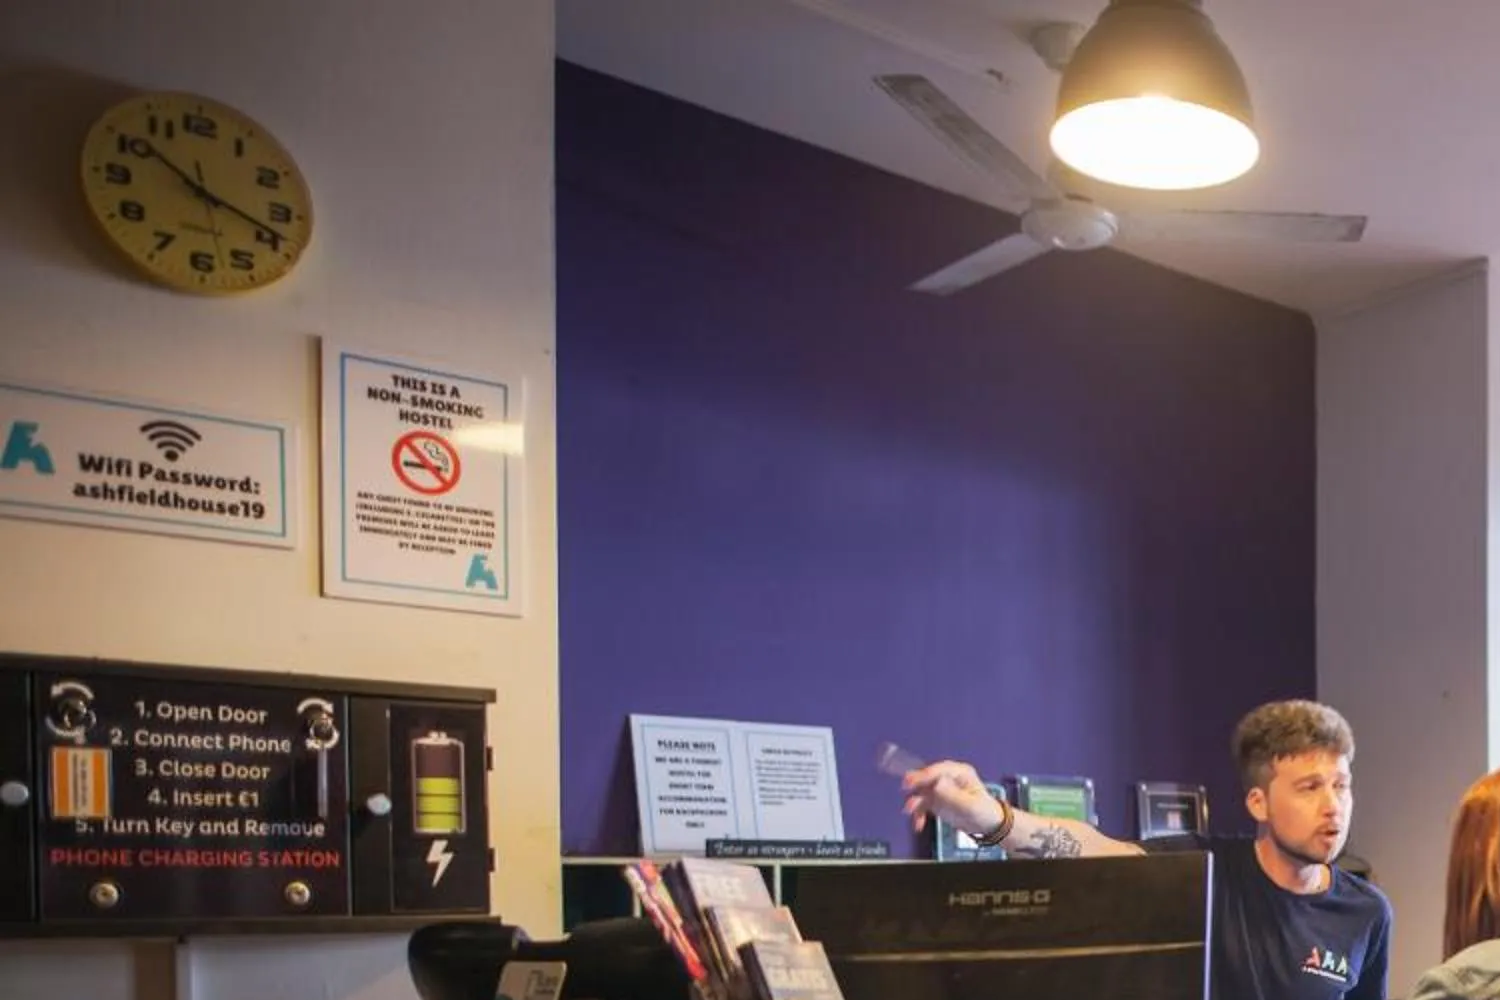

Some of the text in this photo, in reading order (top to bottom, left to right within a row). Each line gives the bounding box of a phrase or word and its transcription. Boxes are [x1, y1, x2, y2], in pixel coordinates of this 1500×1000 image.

[183, 113, 218, 139] 12
[118, 133, 151, 159] 10
[235, 137, 244, 158] 1
[105, 163, 132, 185] 9
[255, 166, 280, 189] 2
[119, 200, 145, 222] 8
[269, 202, 292, 224] 3
[153, 230, 176, 251] 7
[189, 252, 215, 273] 6
[230, 248, 254, 270] 5
[391, 374, 461, 398] THIS IS A
[367, 387, 484, 419] NON-SMOKING
[399, 409, 454, 430] HOSTEL
[78, 452, 261, 495] Wifi Password:
[72, 482, 266, 519] ashfieldhouse19
[135, 702, 268, 724] 1. Open Door
[109, 728, 291, 753] 2. Connect Phone
[135, 759, 271, 780] 3. Close Door
[148, 790, 167, 806] 4.
[173, 789, 234, 808] Insert
[102, 817, 149, 835] Turn
[155, 818, 192, 838] Key
[199, 820, 239, 836] and
[245, 820, 326, 838] Remove
[50, 848, 340, 870] PHONE CHARGING STATION
